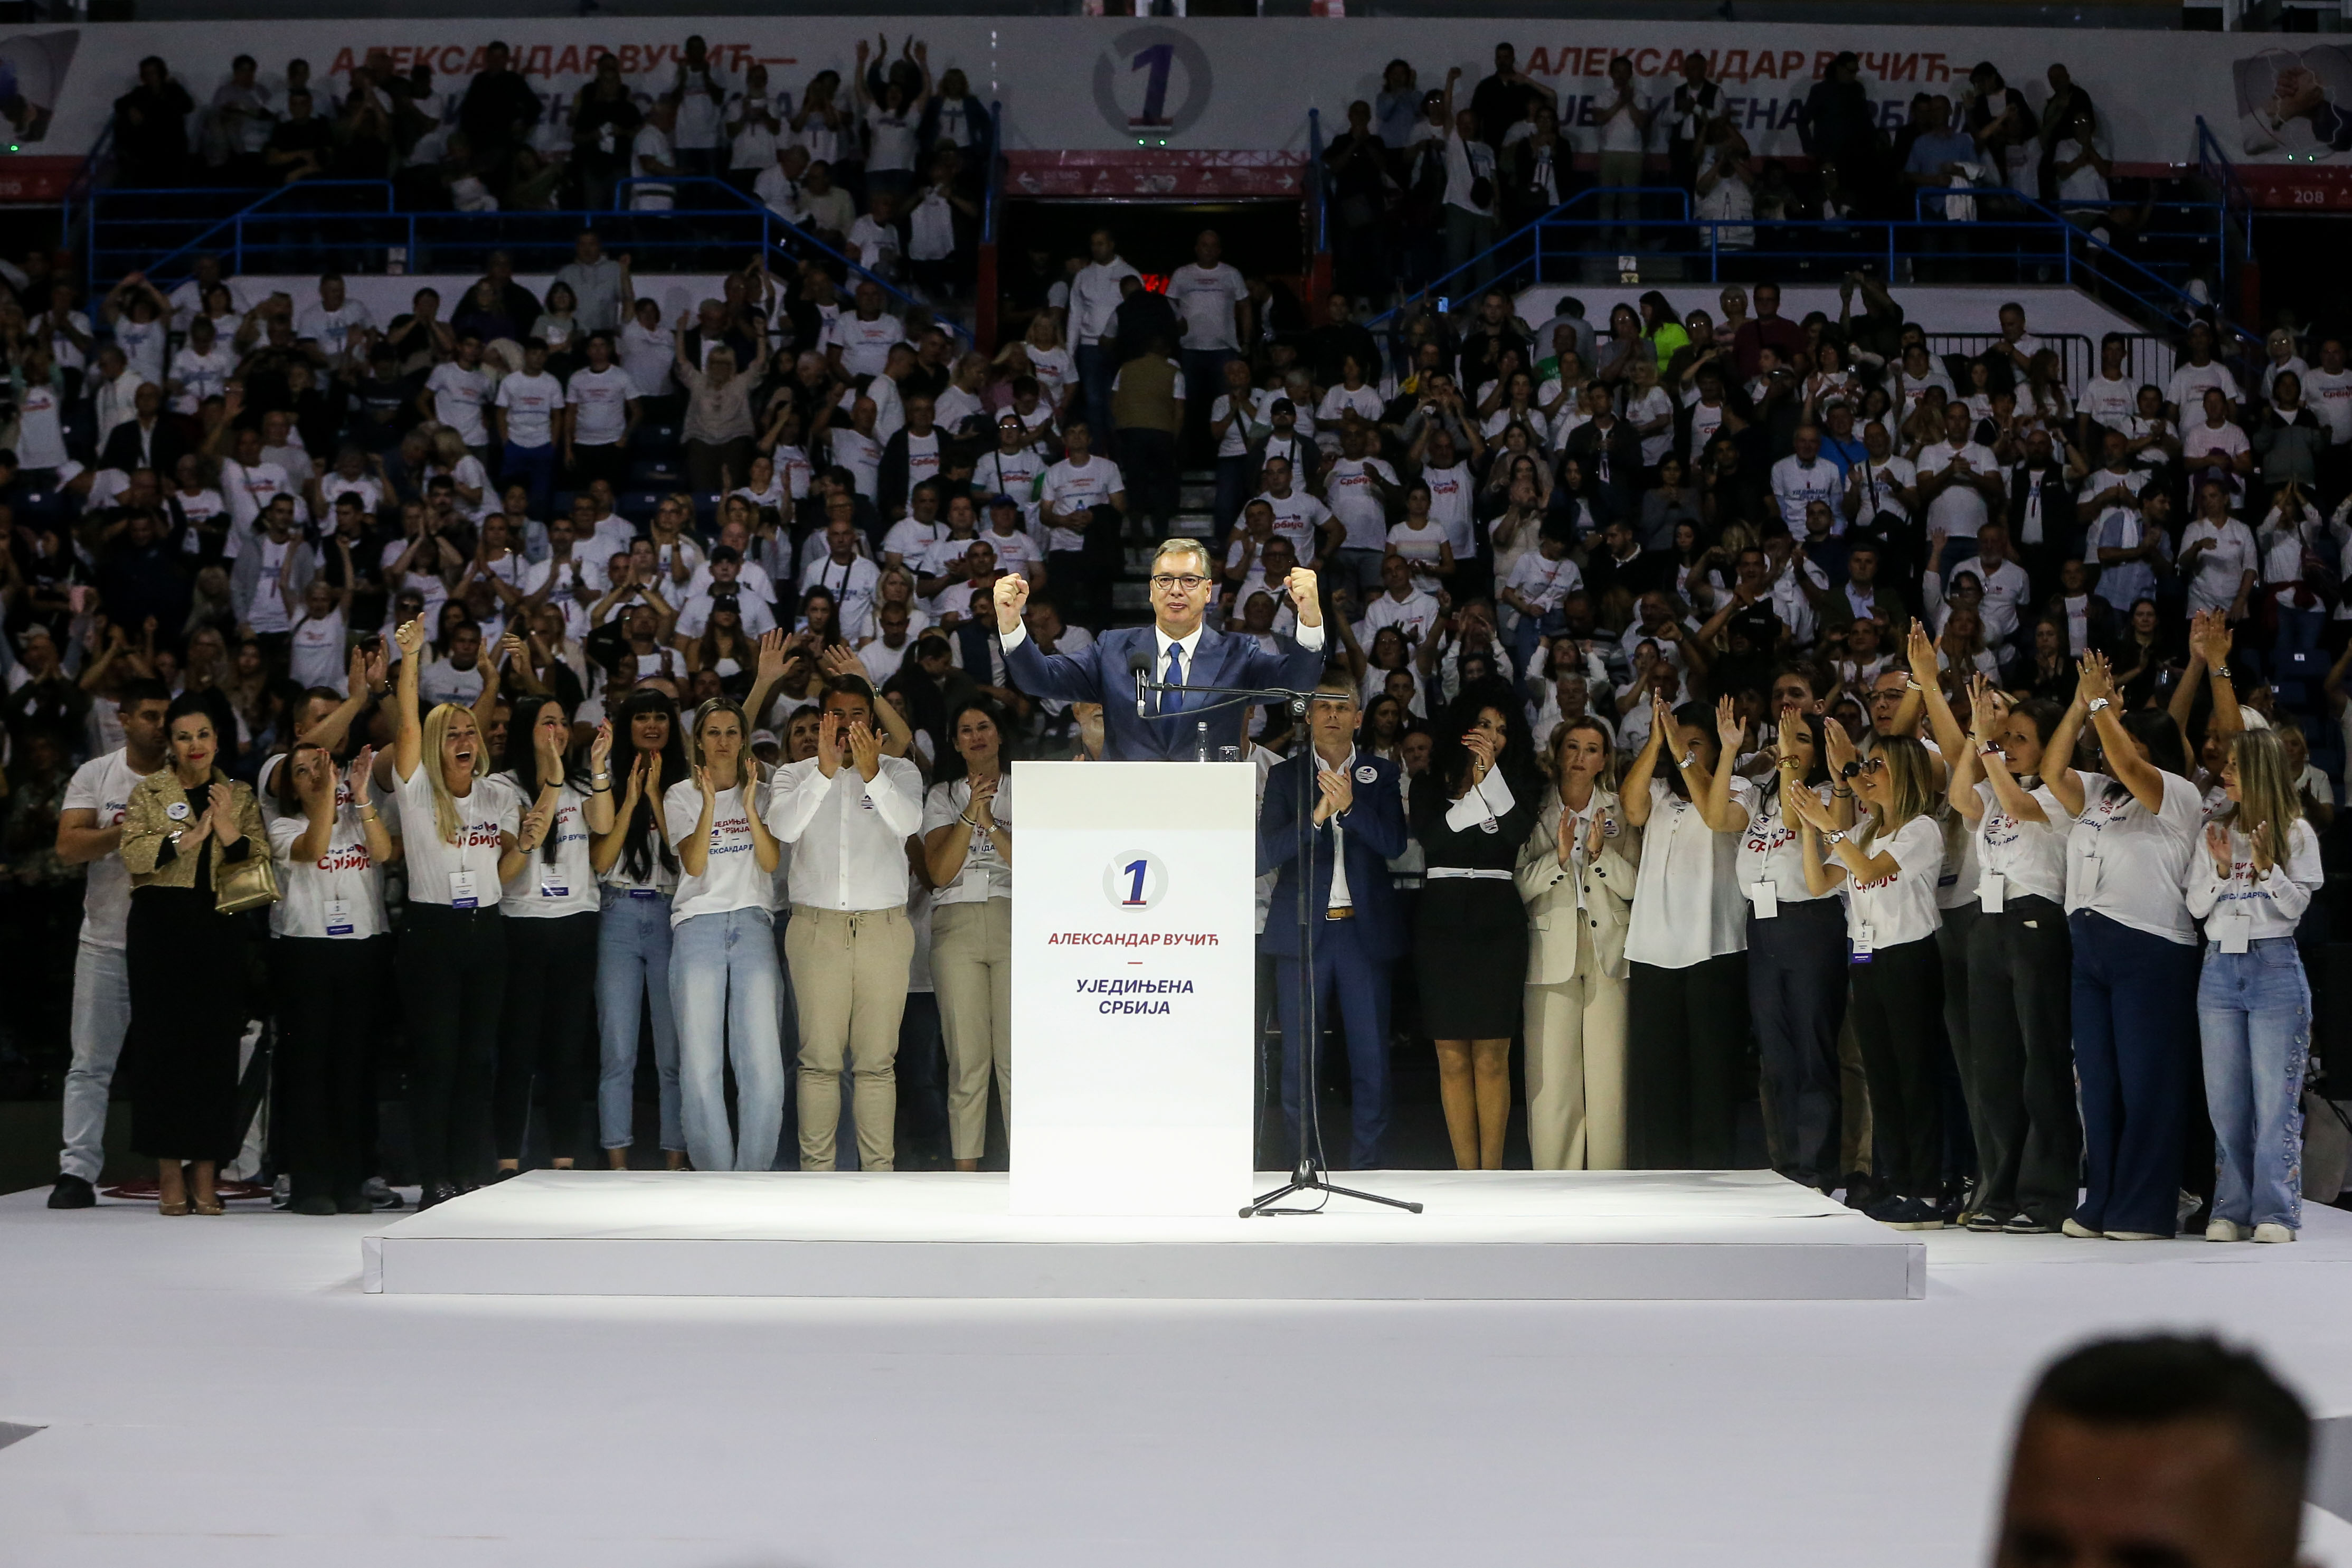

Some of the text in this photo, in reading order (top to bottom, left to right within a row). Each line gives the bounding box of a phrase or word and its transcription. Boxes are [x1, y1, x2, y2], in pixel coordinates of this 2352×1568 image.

[1128, 44, 1174, 130] 1
[2294, 190, 2325, 204] 208
[1273, 521, 1303, 530] рбија
[713, 818, 749, 827] ЈЕДИЊЕ
[709, 844, 748, 855] ЕКСАНДАР
[1122, 859, 1147, 908] 1
[1047, 933, 1219, 947] АЛЕКСАНДАР ВУЧИЋ
[1076, 979, 1194, 996] УЈЕДИЊЕНА
[1098, 1000, 1170, 1015] СРБИЈА
